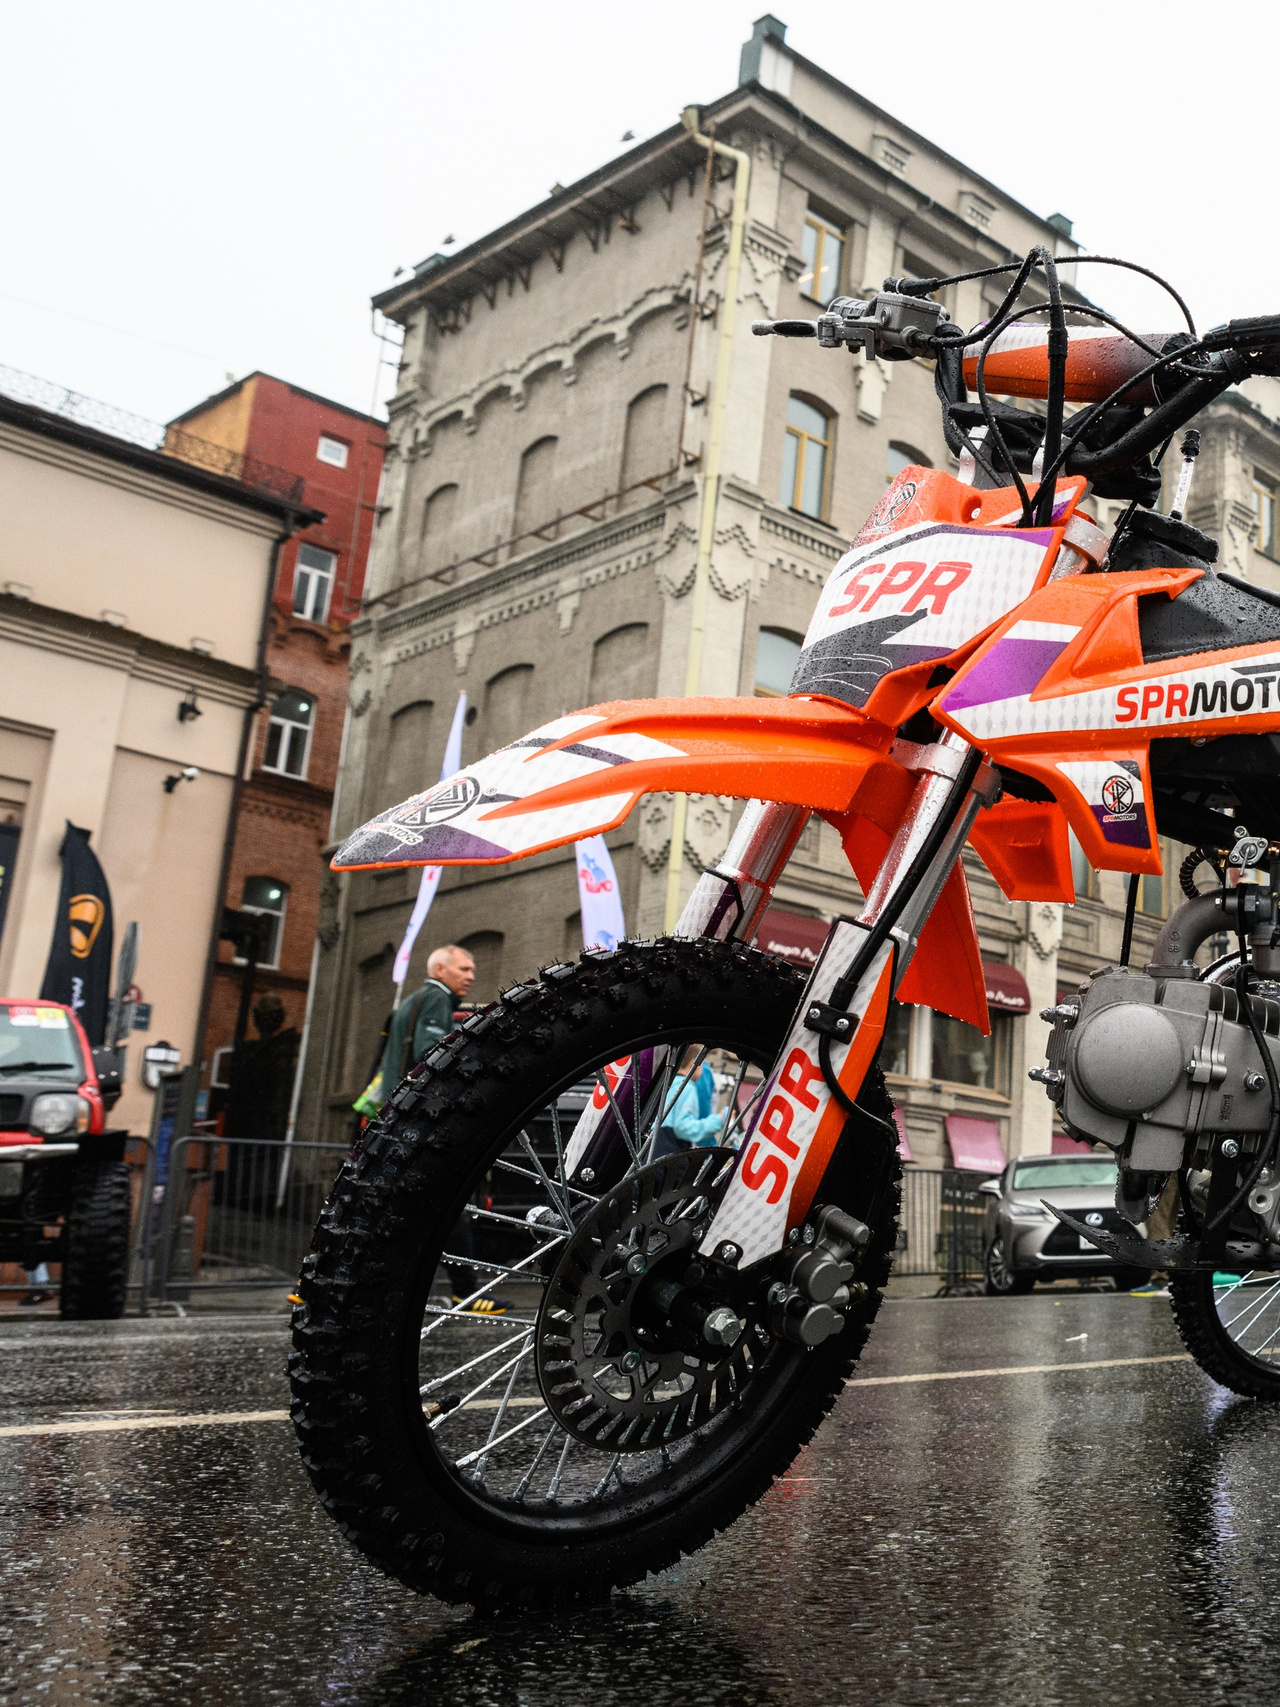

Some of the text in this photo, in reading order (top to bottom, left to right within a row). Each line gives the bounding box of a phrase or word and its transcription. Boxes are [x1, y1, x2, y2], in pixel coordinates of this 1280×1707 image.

[828, 560, 973, 618] SPR
[1104, 813, 1136, 822] SPRMOTORS
[741, 1047, 827, 1205] SPR
